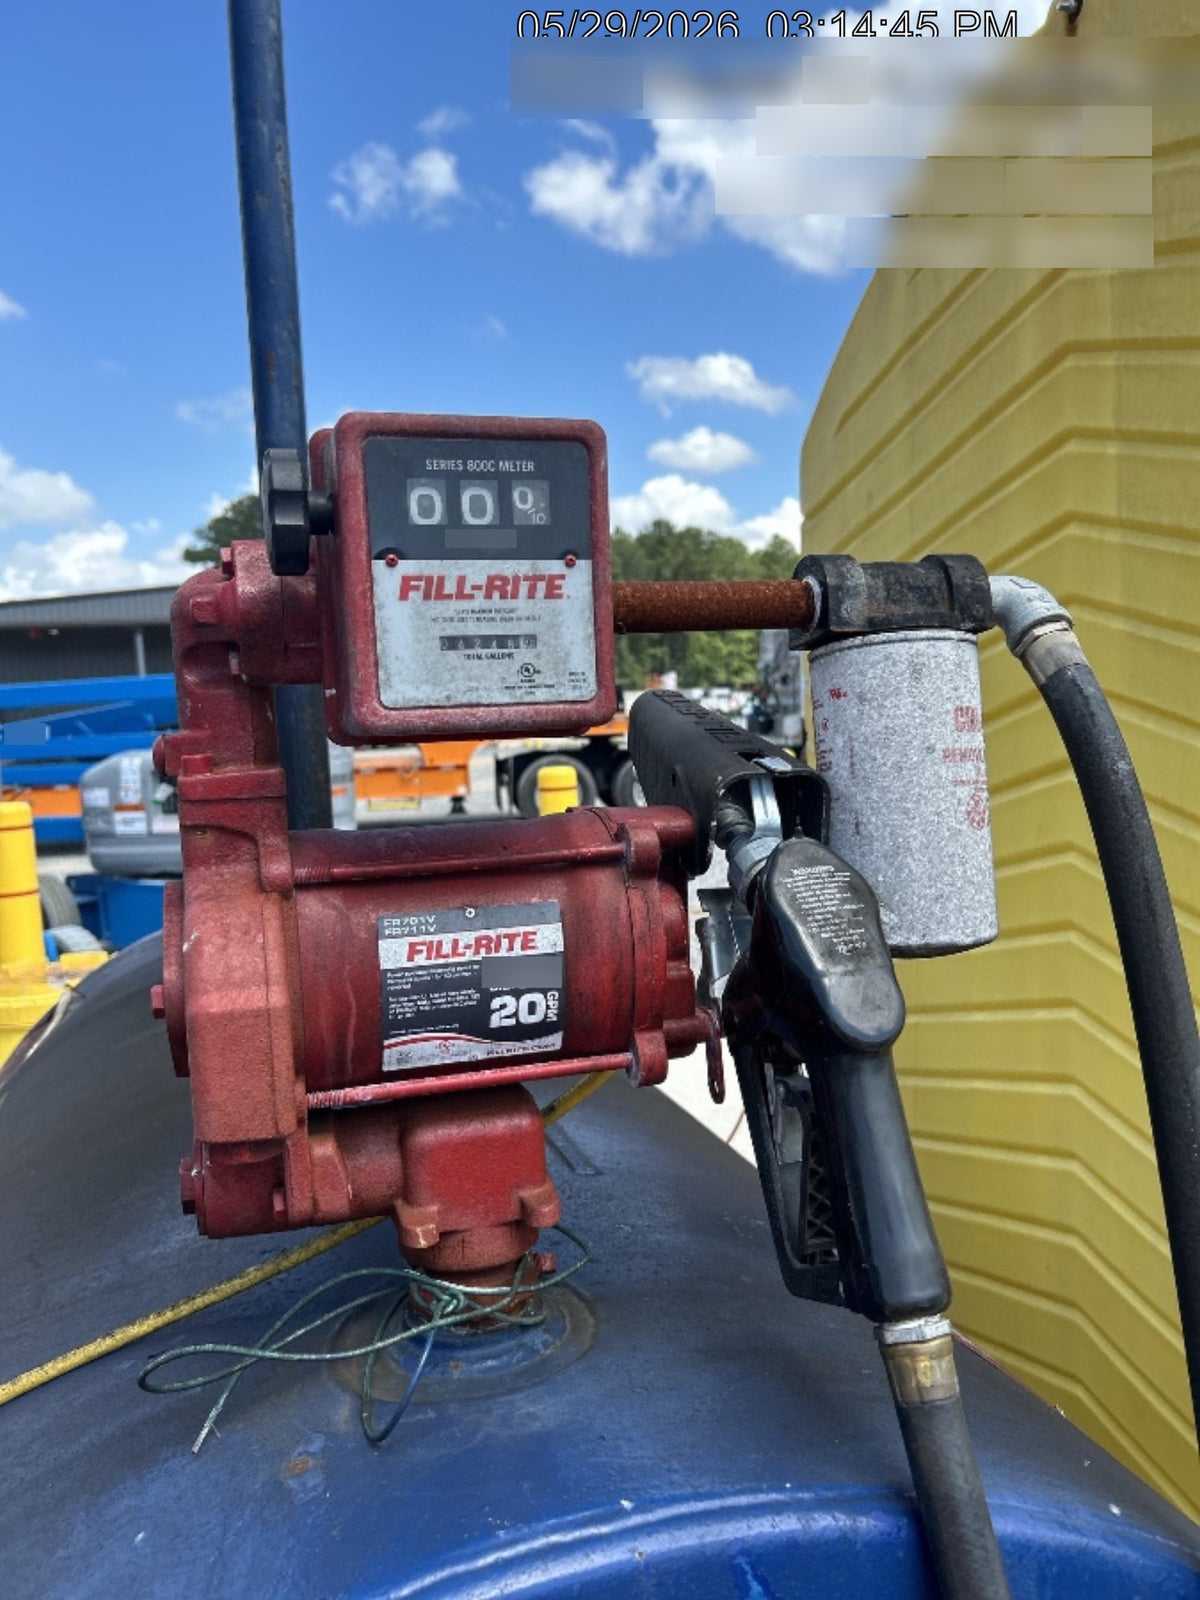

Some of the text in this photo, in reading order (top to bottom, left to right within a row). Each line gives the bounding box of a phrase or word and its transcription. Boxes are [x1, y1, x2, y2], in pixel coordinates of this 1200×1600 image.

[425, 459, 463, 471] SERIES
[498, 459, 534, 472] METER
[398, 573, 567, 601] FILL-RITE
[406, 931, 539, 962] FILL-RITE
[489, 992, 547, 1029] 20
[546, 990, 559, 1022] GPM
